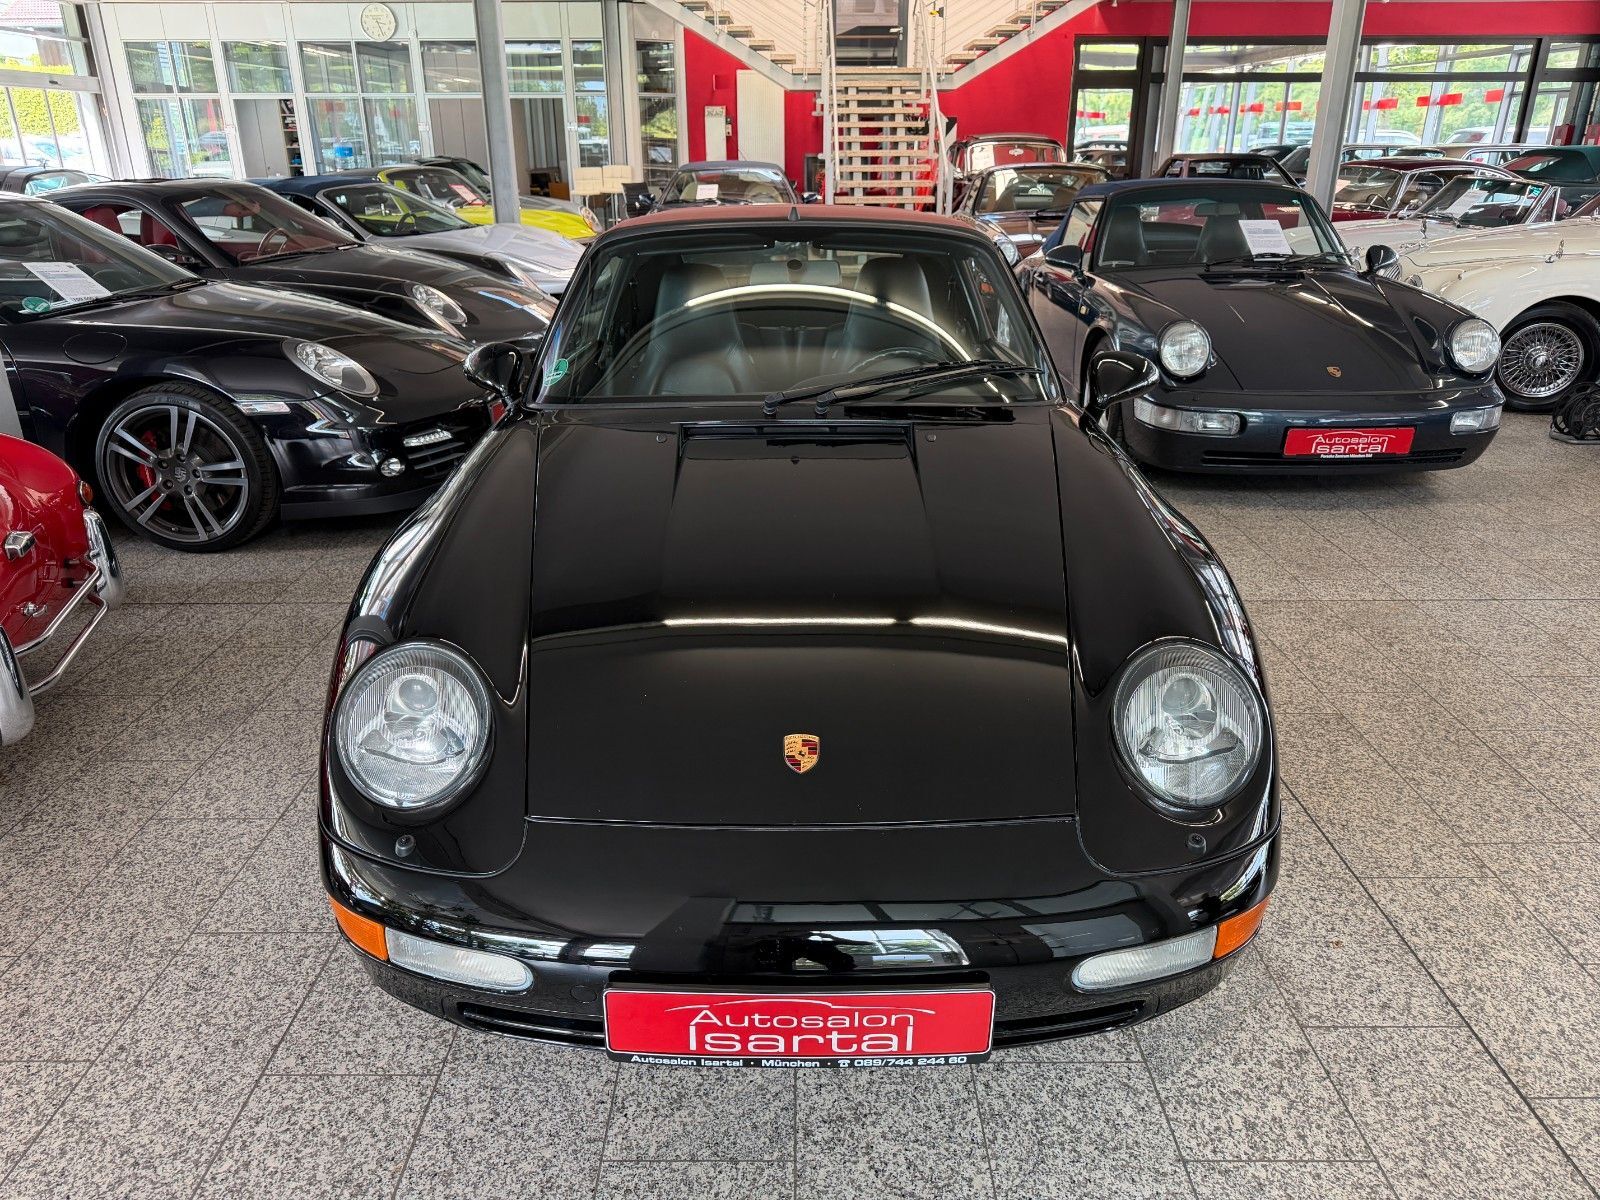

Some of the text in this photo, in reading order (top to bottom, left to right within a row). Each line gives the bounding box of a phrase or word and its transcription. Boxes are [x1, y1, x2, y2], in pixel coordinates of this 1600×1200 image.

[1311, 440, 1388, 454] Isartal
[1315, 436, 1388, 444] Autosalon
[690, 1009, 914, 1028] Autosalon
[689, 1025, 914, 1053] Isartal
[630, 1054, 967, 1068] Autosalon Isartal München 089/744 244 60
